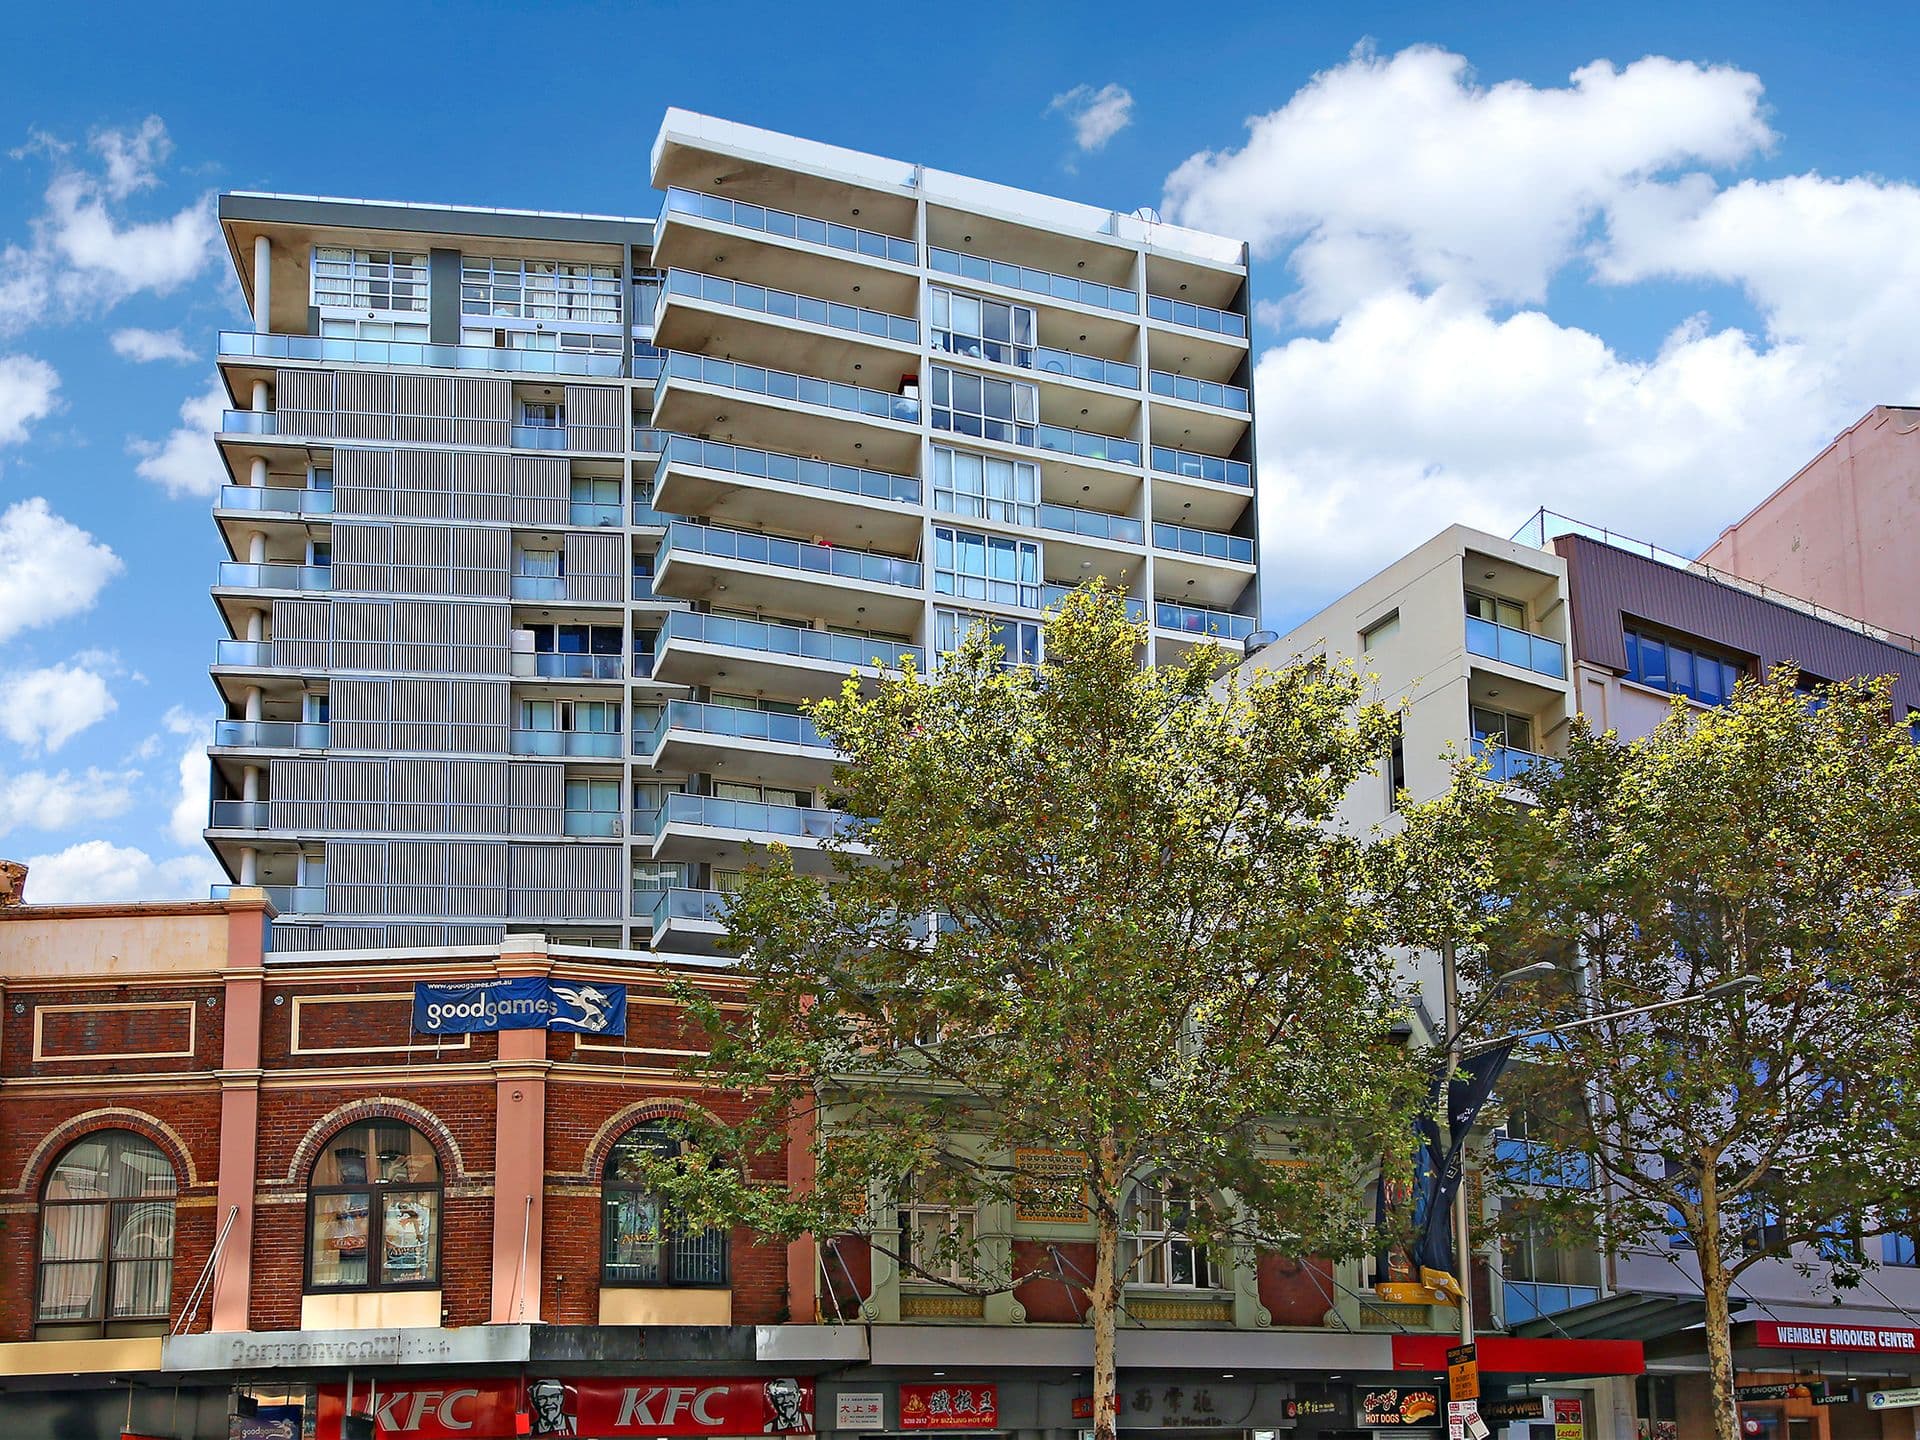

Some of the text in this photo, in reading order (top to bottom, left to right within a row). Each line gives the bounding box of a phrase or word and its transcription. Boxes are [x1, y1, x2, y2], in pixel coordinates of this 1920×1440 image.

[427, 992, 558, 1029] goodgames
[1777, 1326, 1916, 1349] WEMBLEY SNOOKER CENTER
[1751, 1385, 1788, 1394] SNOOKER
[1824, 1395, 1849, 1404] COFFEE
[364, 1389, 478, 1431] KFC
[614, 1386, 730, 1427] KFC
[1365, 1413, 1400, 1424] HOT DOGS
